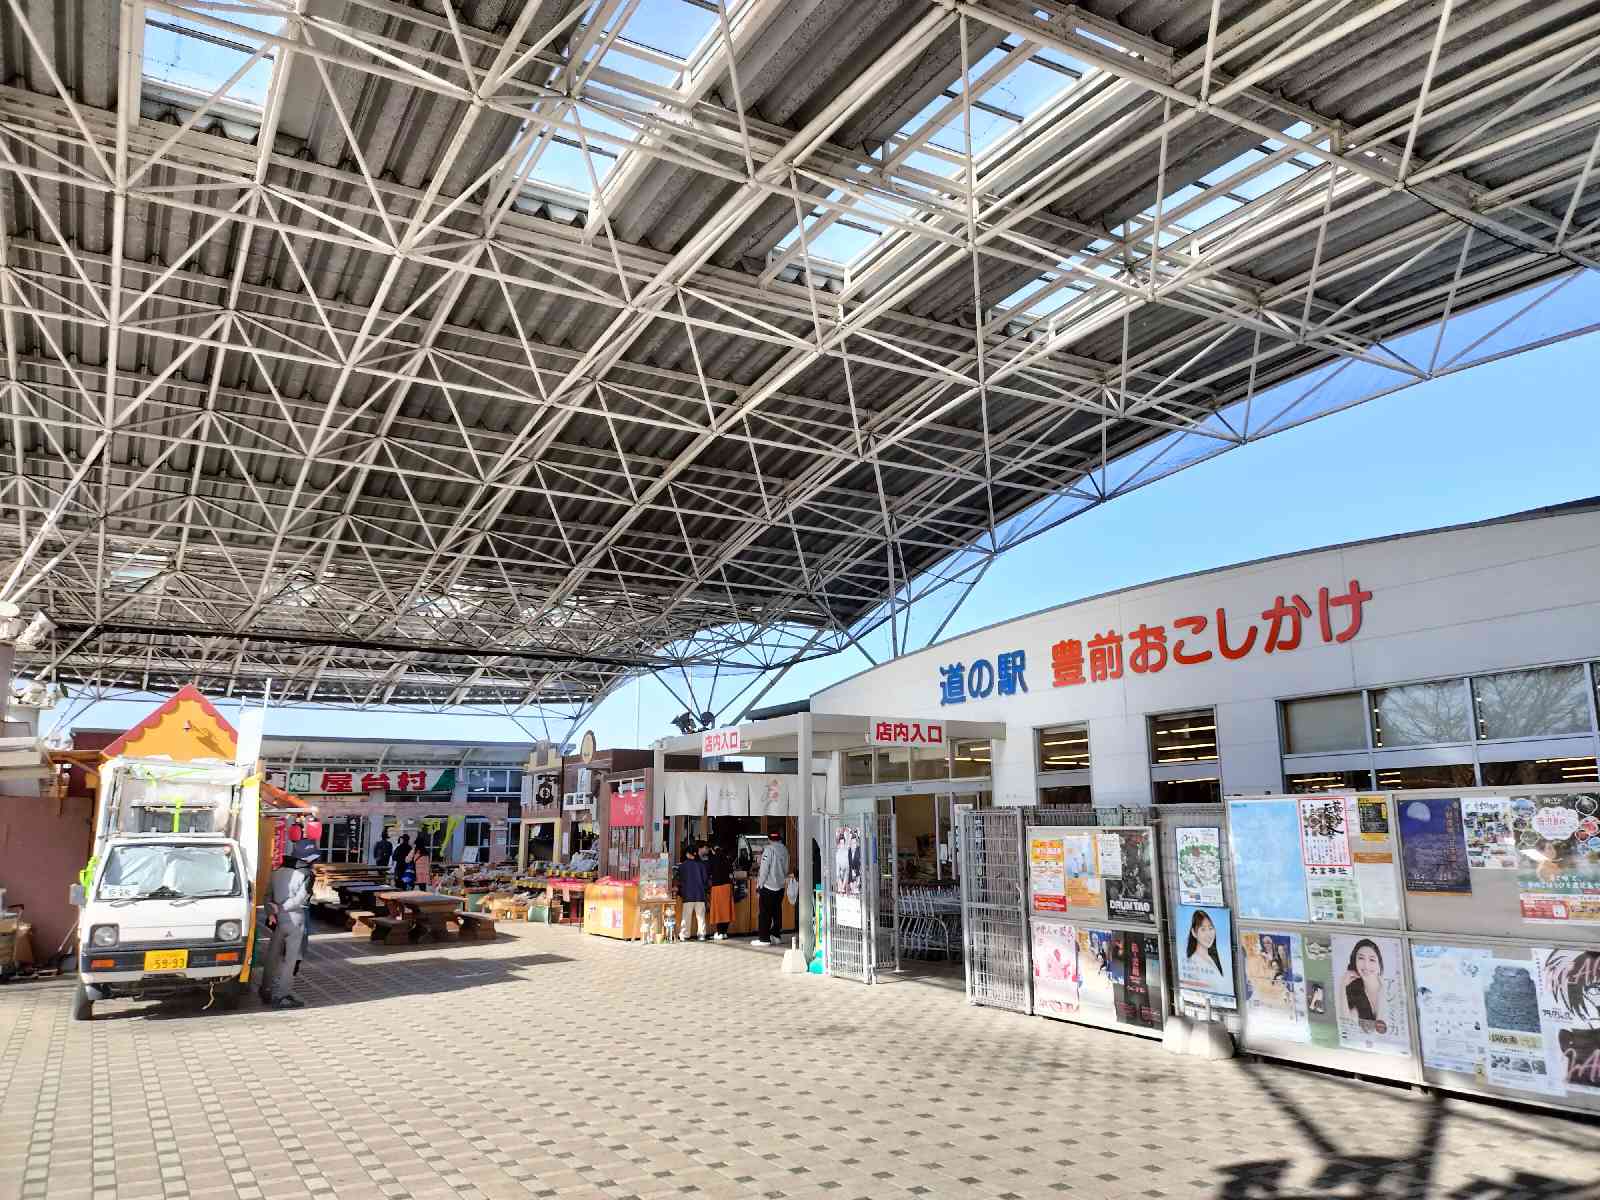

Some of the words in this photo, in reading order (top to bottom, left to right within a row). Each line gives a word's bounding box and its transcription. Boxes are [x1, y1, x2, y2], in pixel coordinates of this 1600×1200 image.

[939, 649, 1027, 706] 道の駅
[1051, 579, 1374, 688] 豊前おこしかけ
[704, 731, 738, 753] 店内入口
[875, 722, 943, 744] 店内入口
[320, 770, 427, 792] 屋台村
